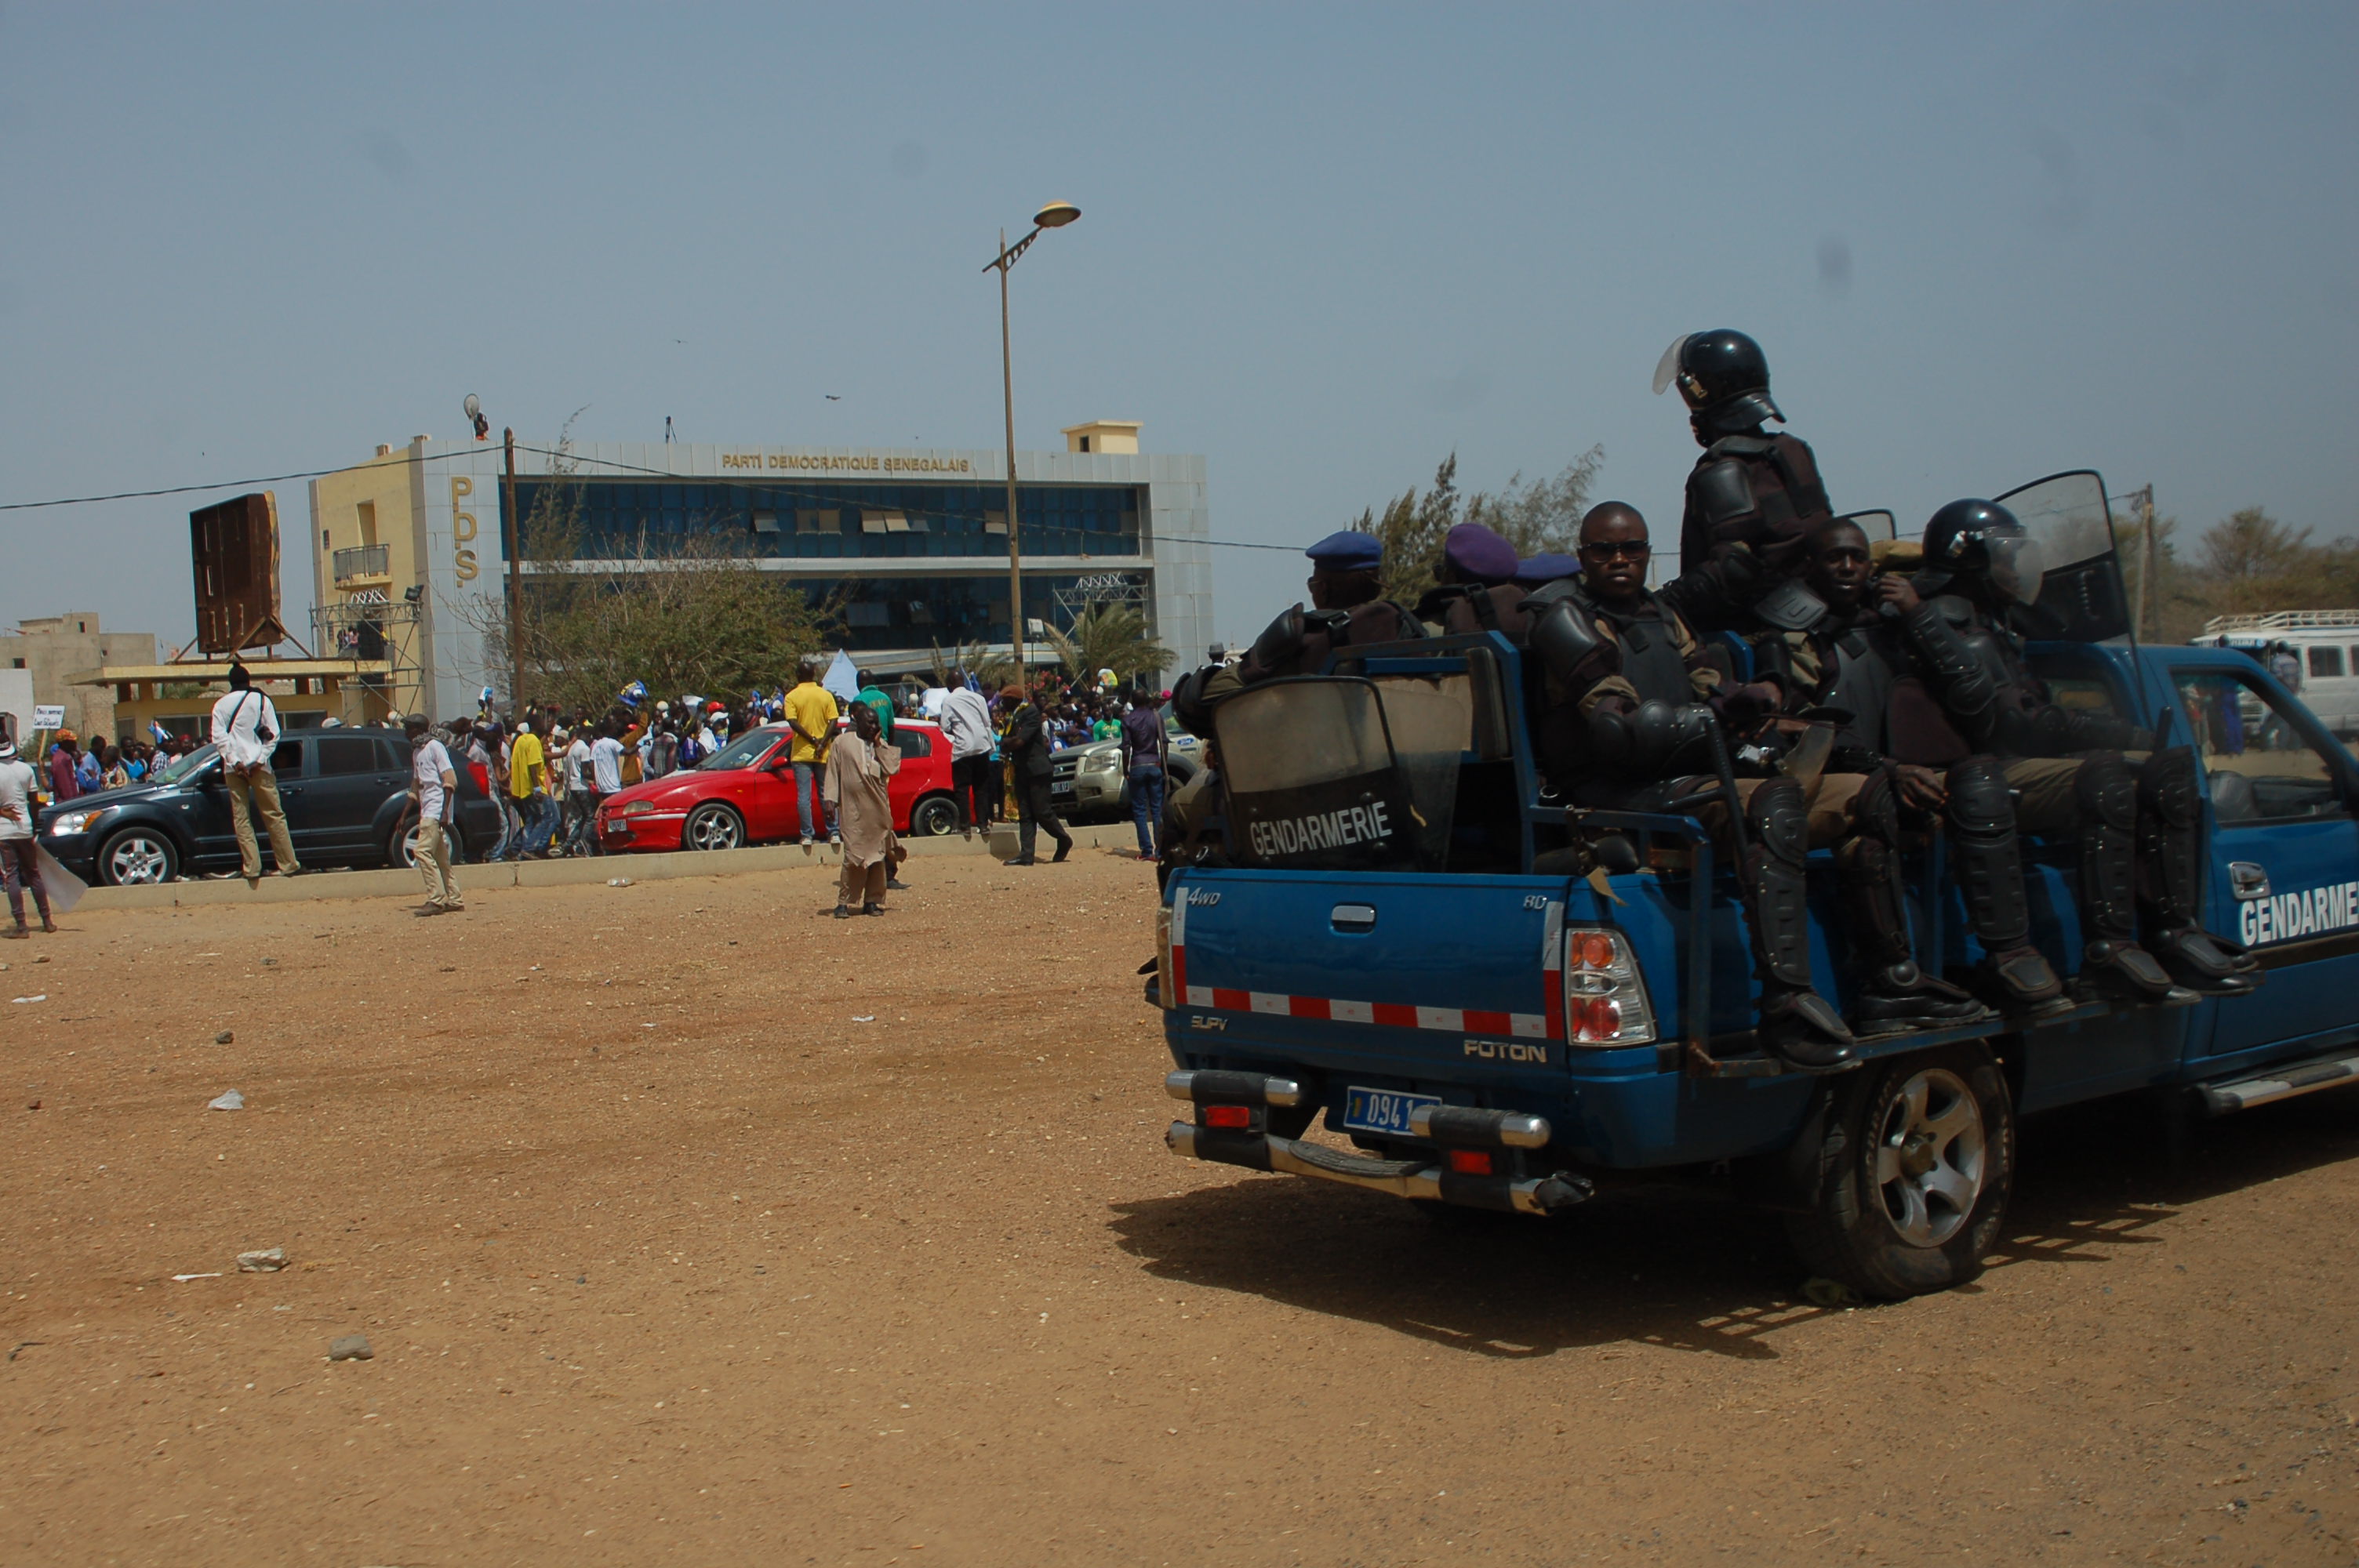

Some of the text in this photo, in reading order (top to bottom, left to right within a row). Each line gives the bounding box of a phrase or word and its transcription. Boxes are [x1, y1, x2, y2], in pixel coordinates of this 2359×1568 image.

[722, 453, 969, 472] PARTI DEMOCRATIQUE SENEGALAIS
[1249, 800, 1393, 856] GENDARMERIE
[1187, 887, 1221, 906] 4WD
[2241, 880, 2359, 947] GENDARME
[1463, 1040, 1548, 1063] FOTON
